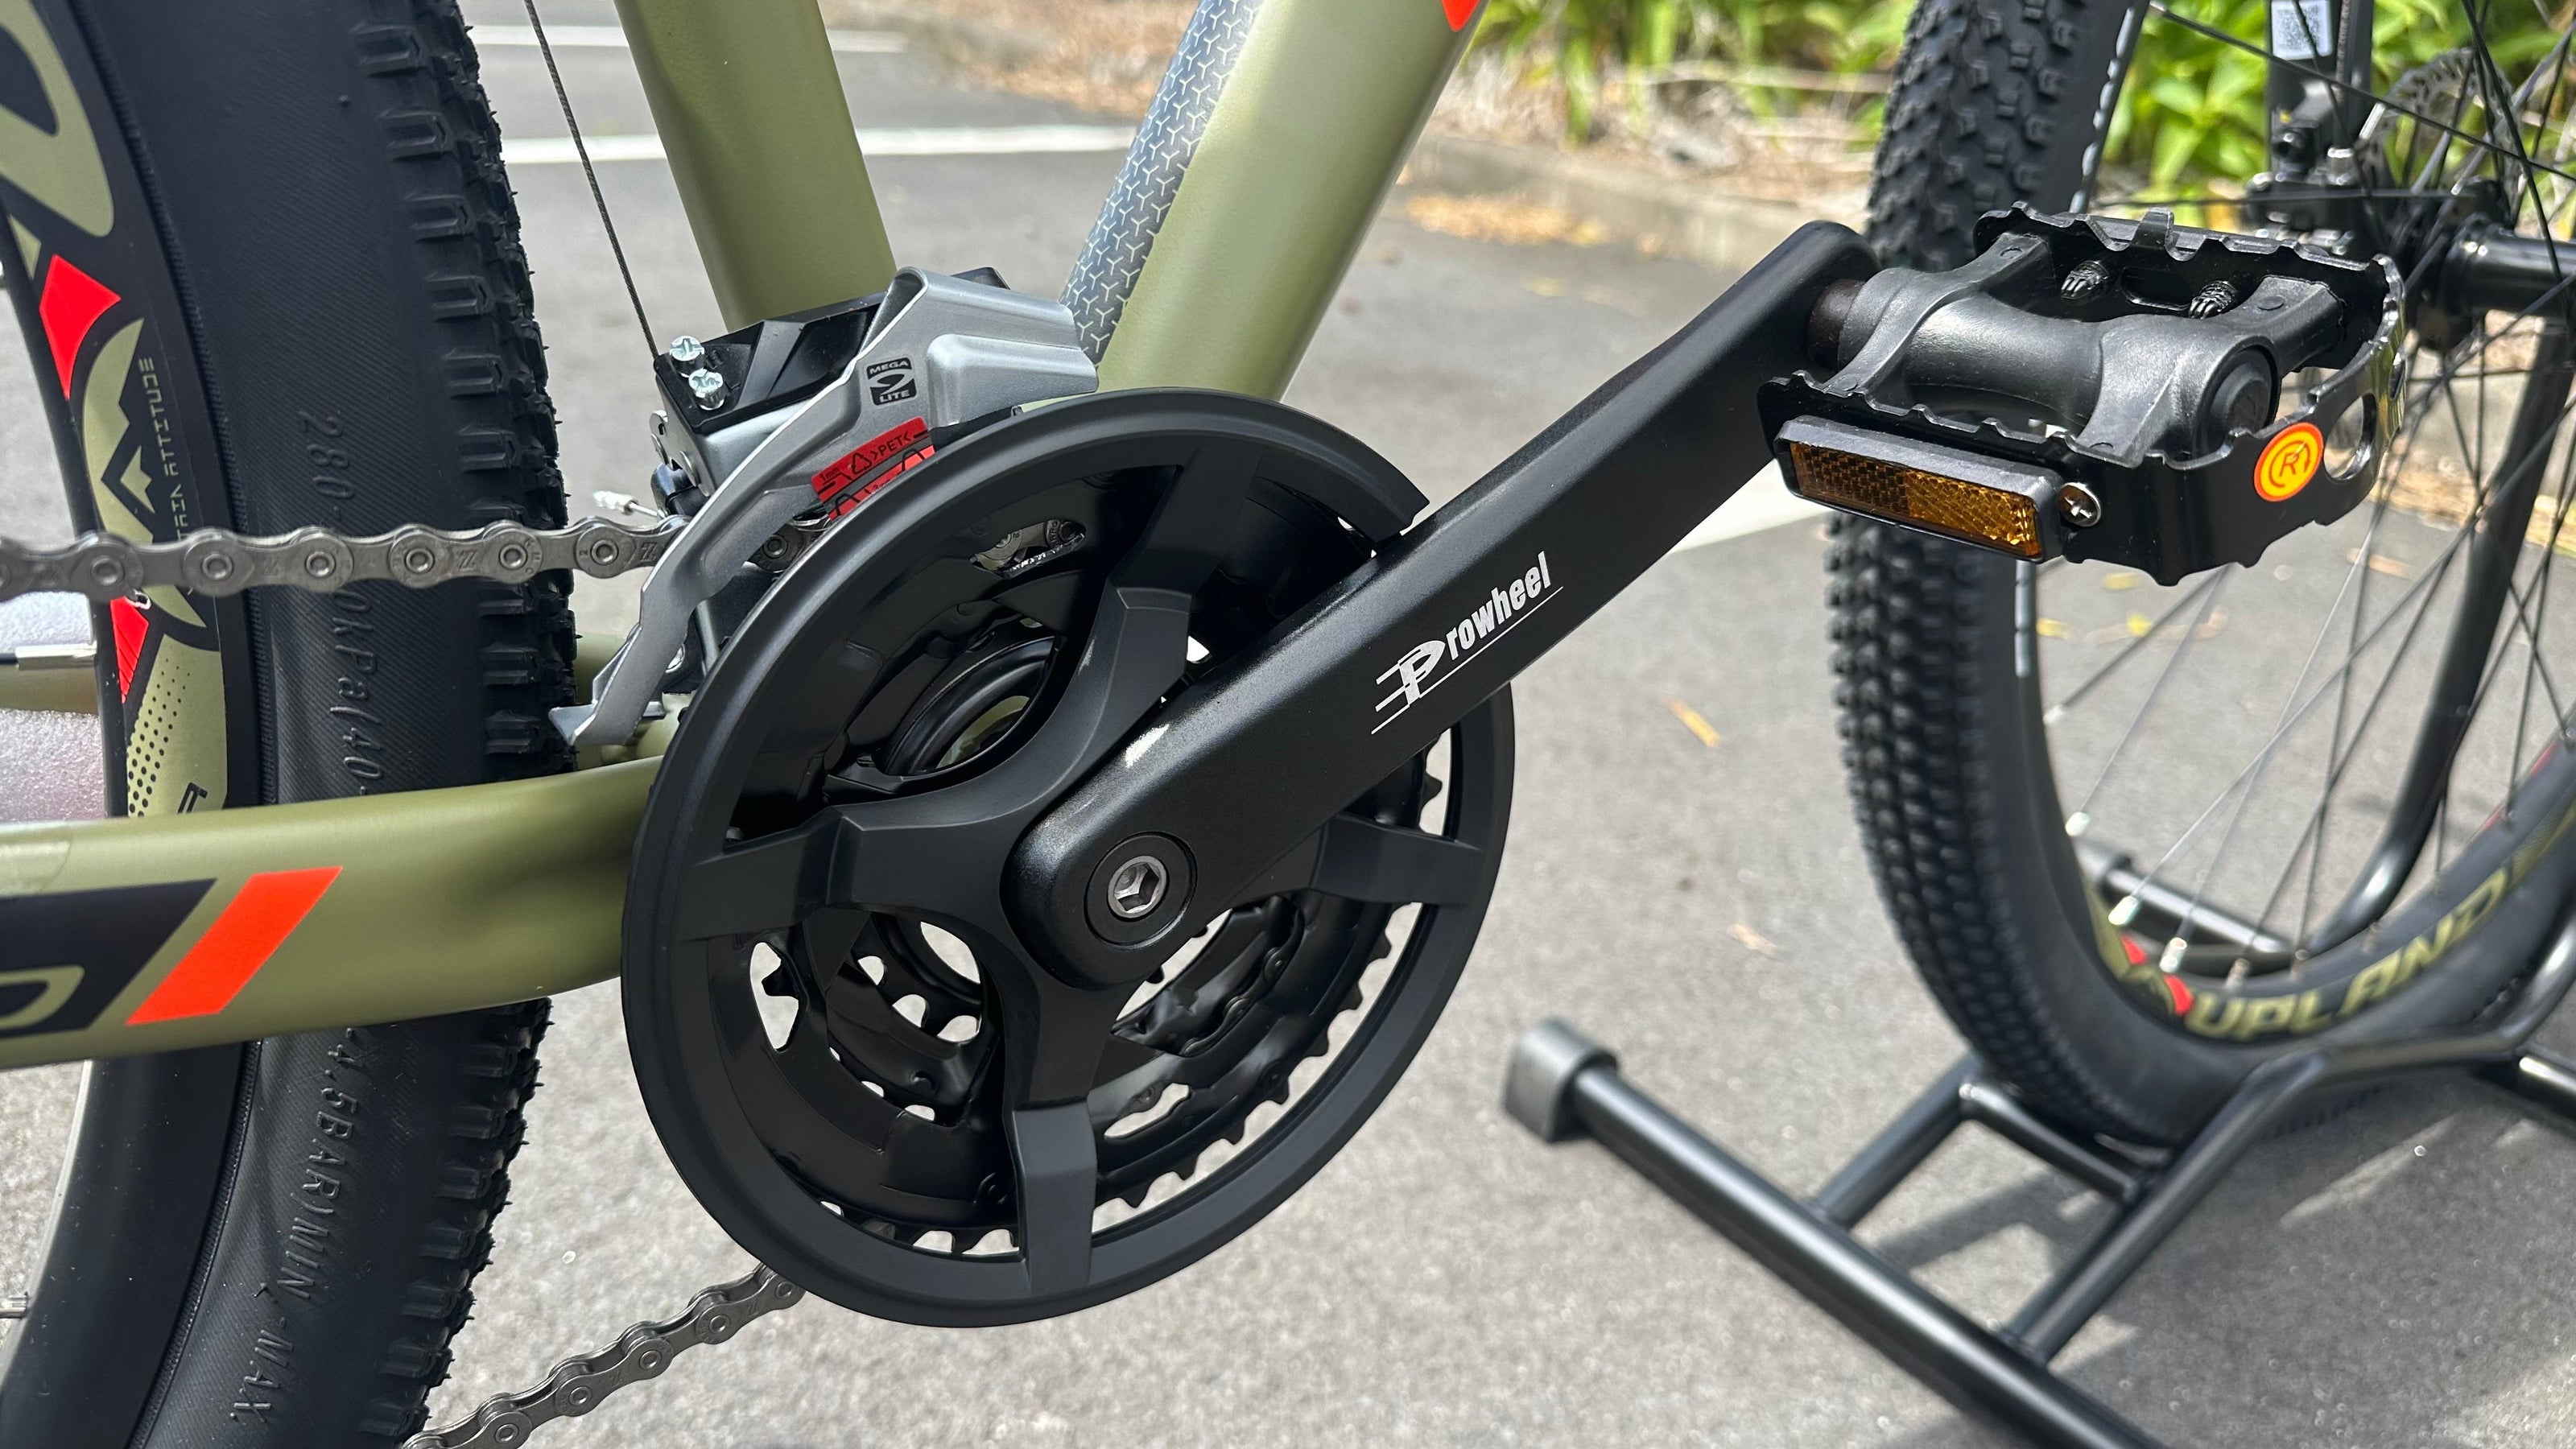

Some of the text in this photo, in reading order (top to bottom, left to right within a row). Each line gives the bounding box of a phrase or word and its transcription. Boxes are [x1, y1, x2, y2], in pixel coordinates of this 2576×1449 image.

[138, 357, 179, 477] ATTITUDE
[869, 361, 909, 374] MEGA
[879, 389, 910, 402] LITE
[1375, 550, 1552, 712] Prowheel
[2185, 865, 2510, 1042] UPLAND
